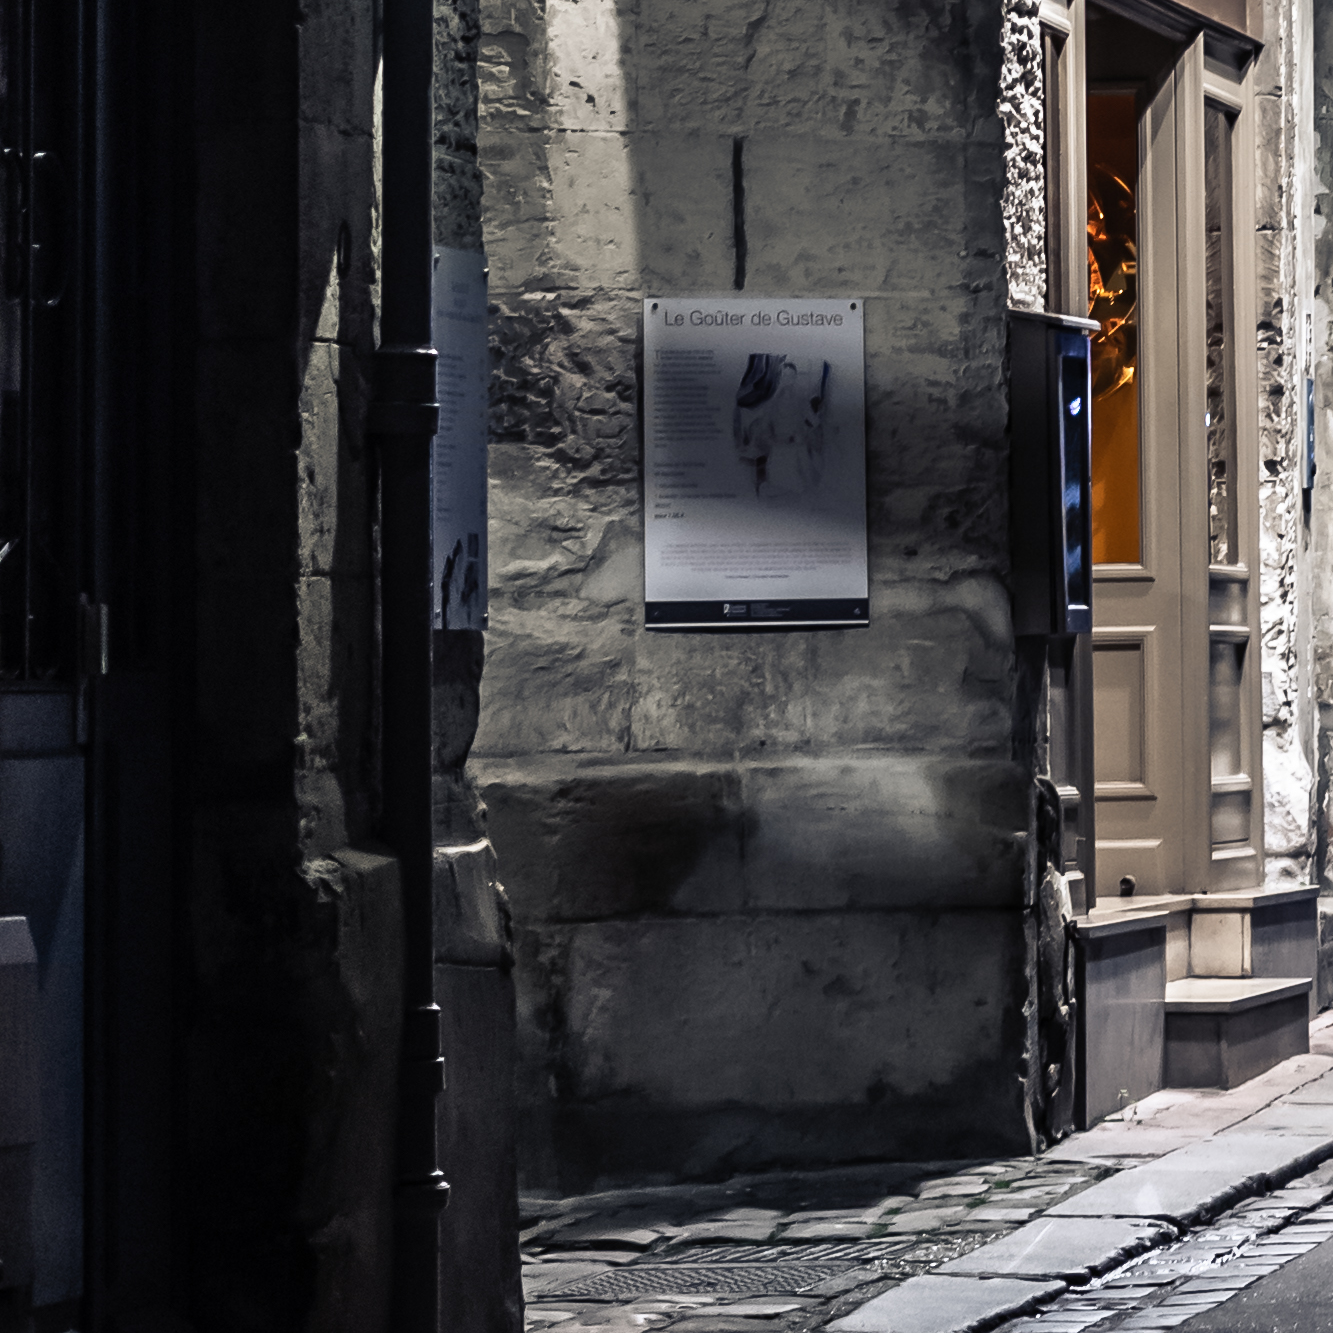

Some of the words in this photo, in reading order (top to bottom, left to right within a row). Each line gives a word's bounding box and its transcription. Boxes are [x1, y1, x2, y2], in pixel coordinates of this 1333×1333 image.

[664, 309, 685, 327] Le
[689, 307, 746, 327] Goûter
[750, 309, 772, 327] de
[776, 308, 844, 327] Gustave
